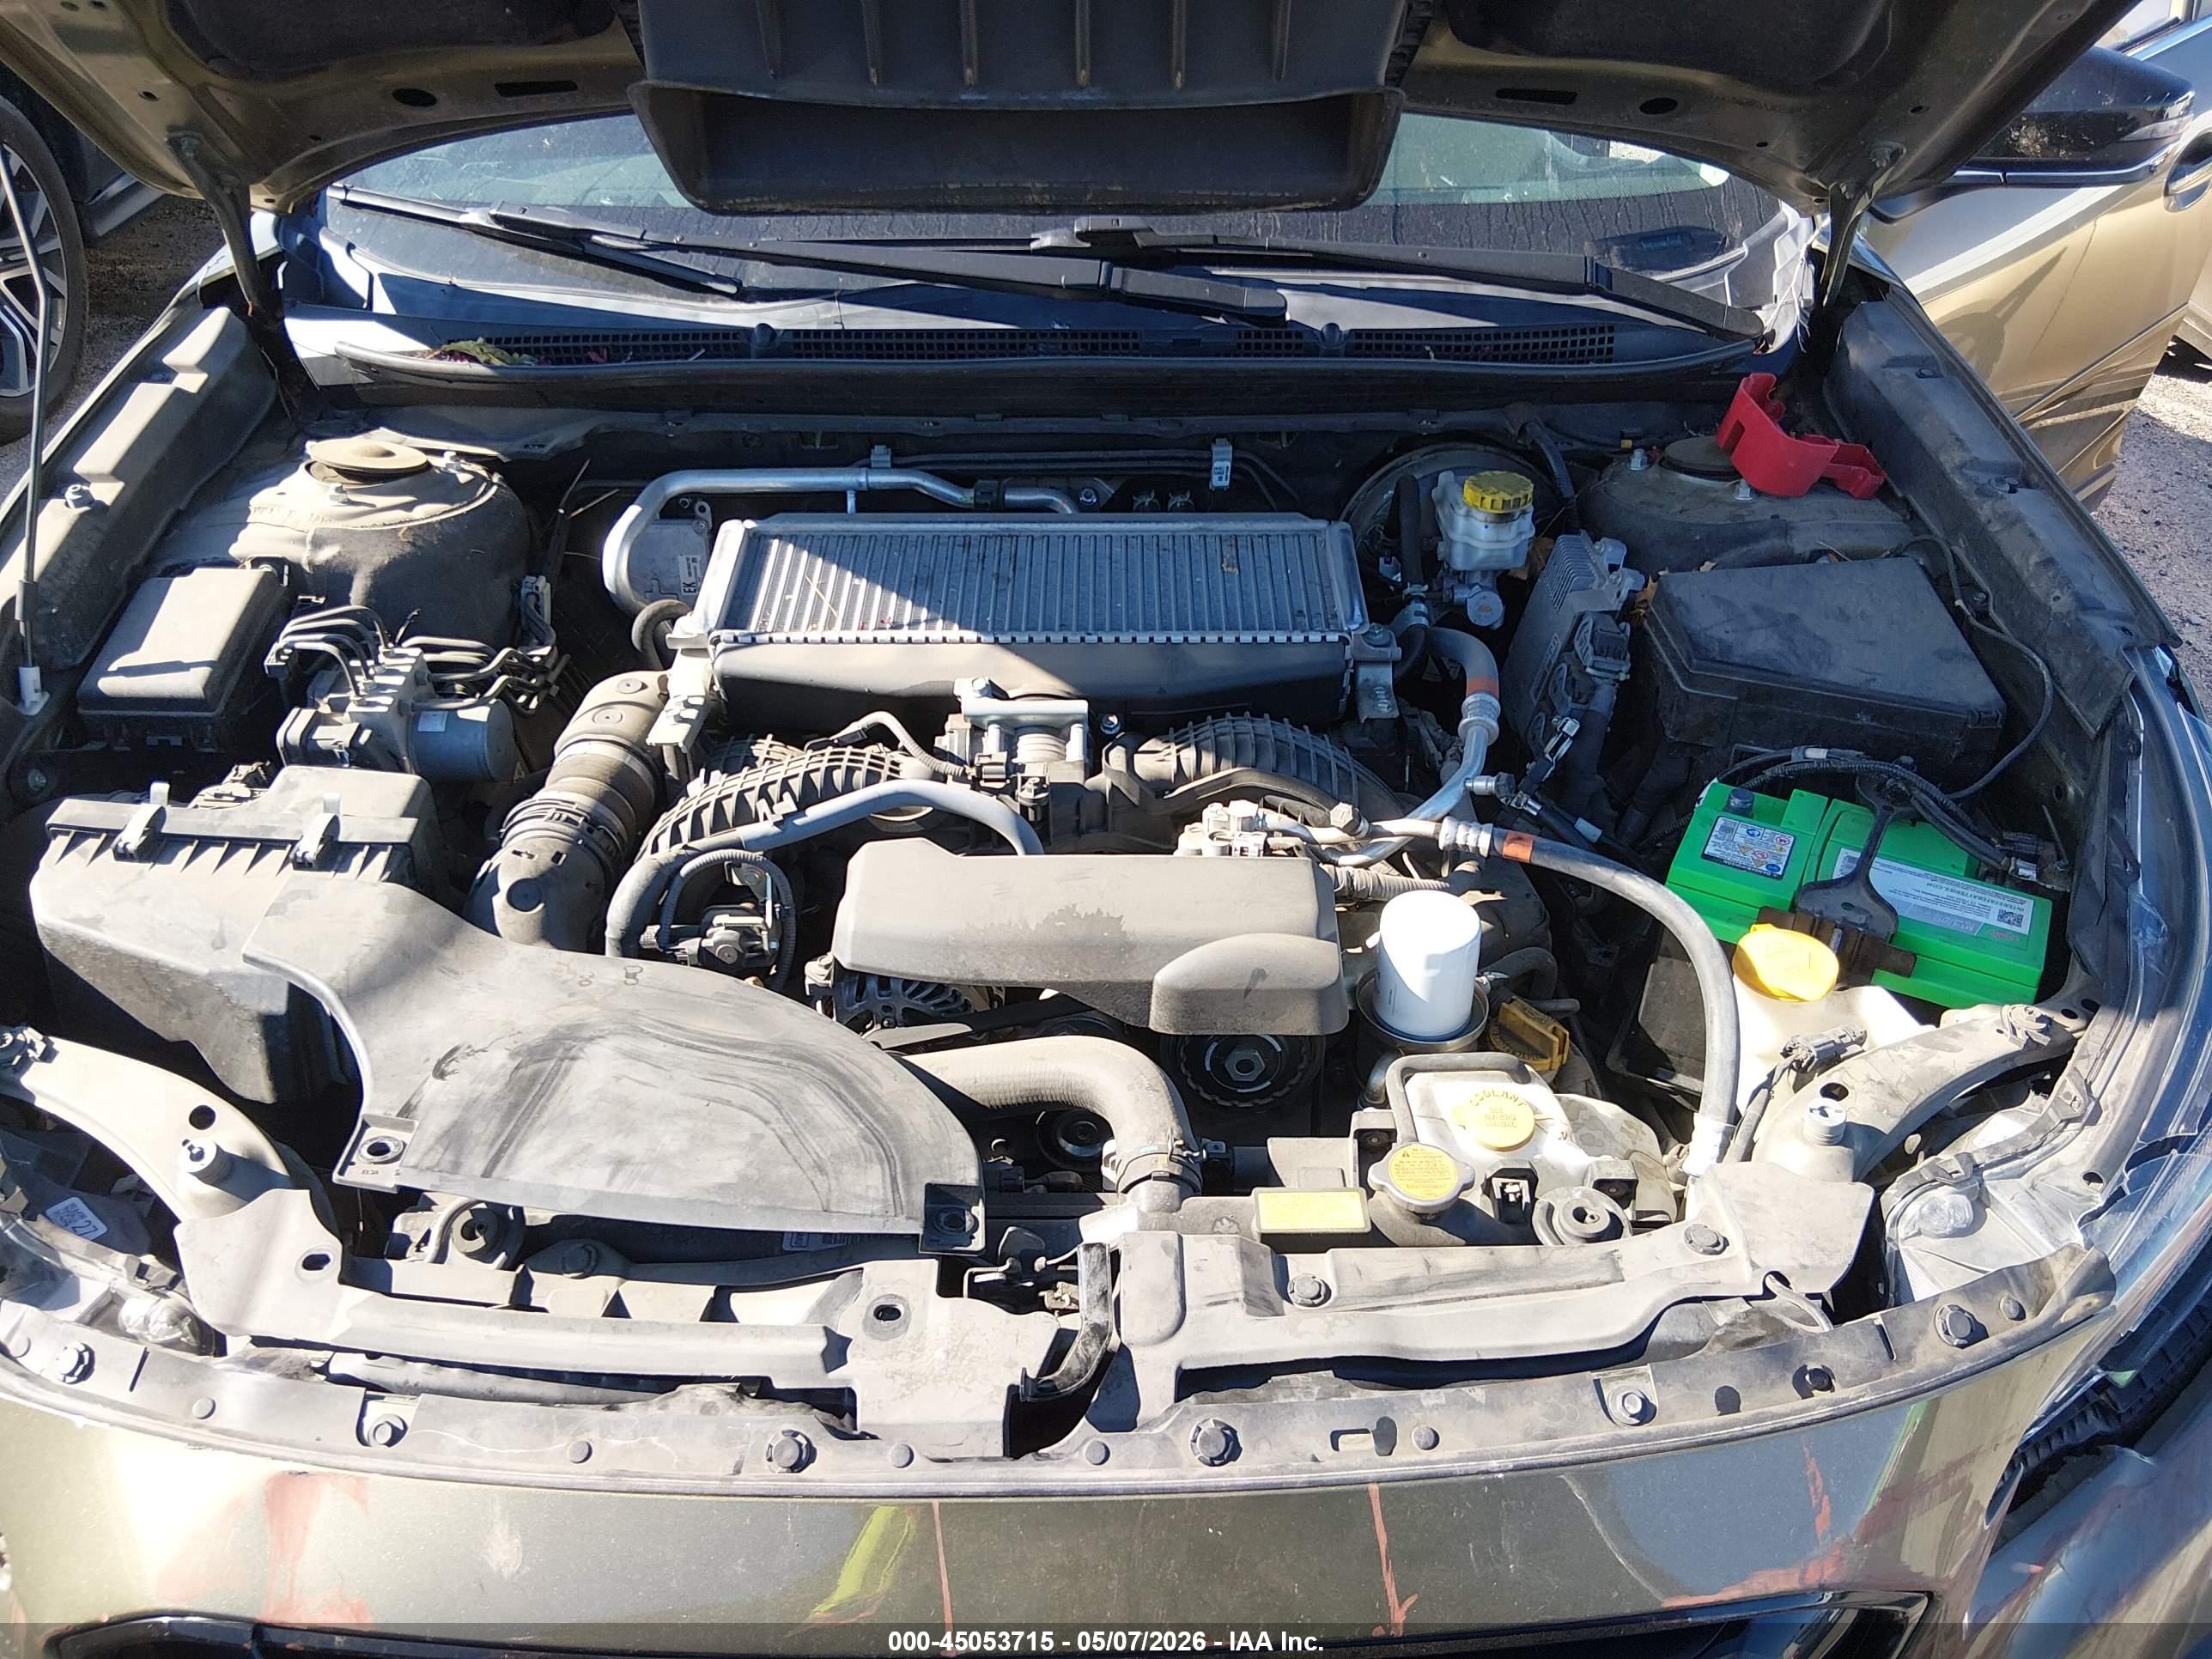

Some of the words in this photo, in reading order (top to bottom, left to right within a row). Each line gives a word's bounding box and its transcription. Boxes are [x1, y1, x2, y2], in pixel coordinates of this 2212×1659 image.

[683, 582, 696, 593] EK
[1469, 1089, 1527, 1107] COOLANT
[71, 1220, 98, 1237] 27
